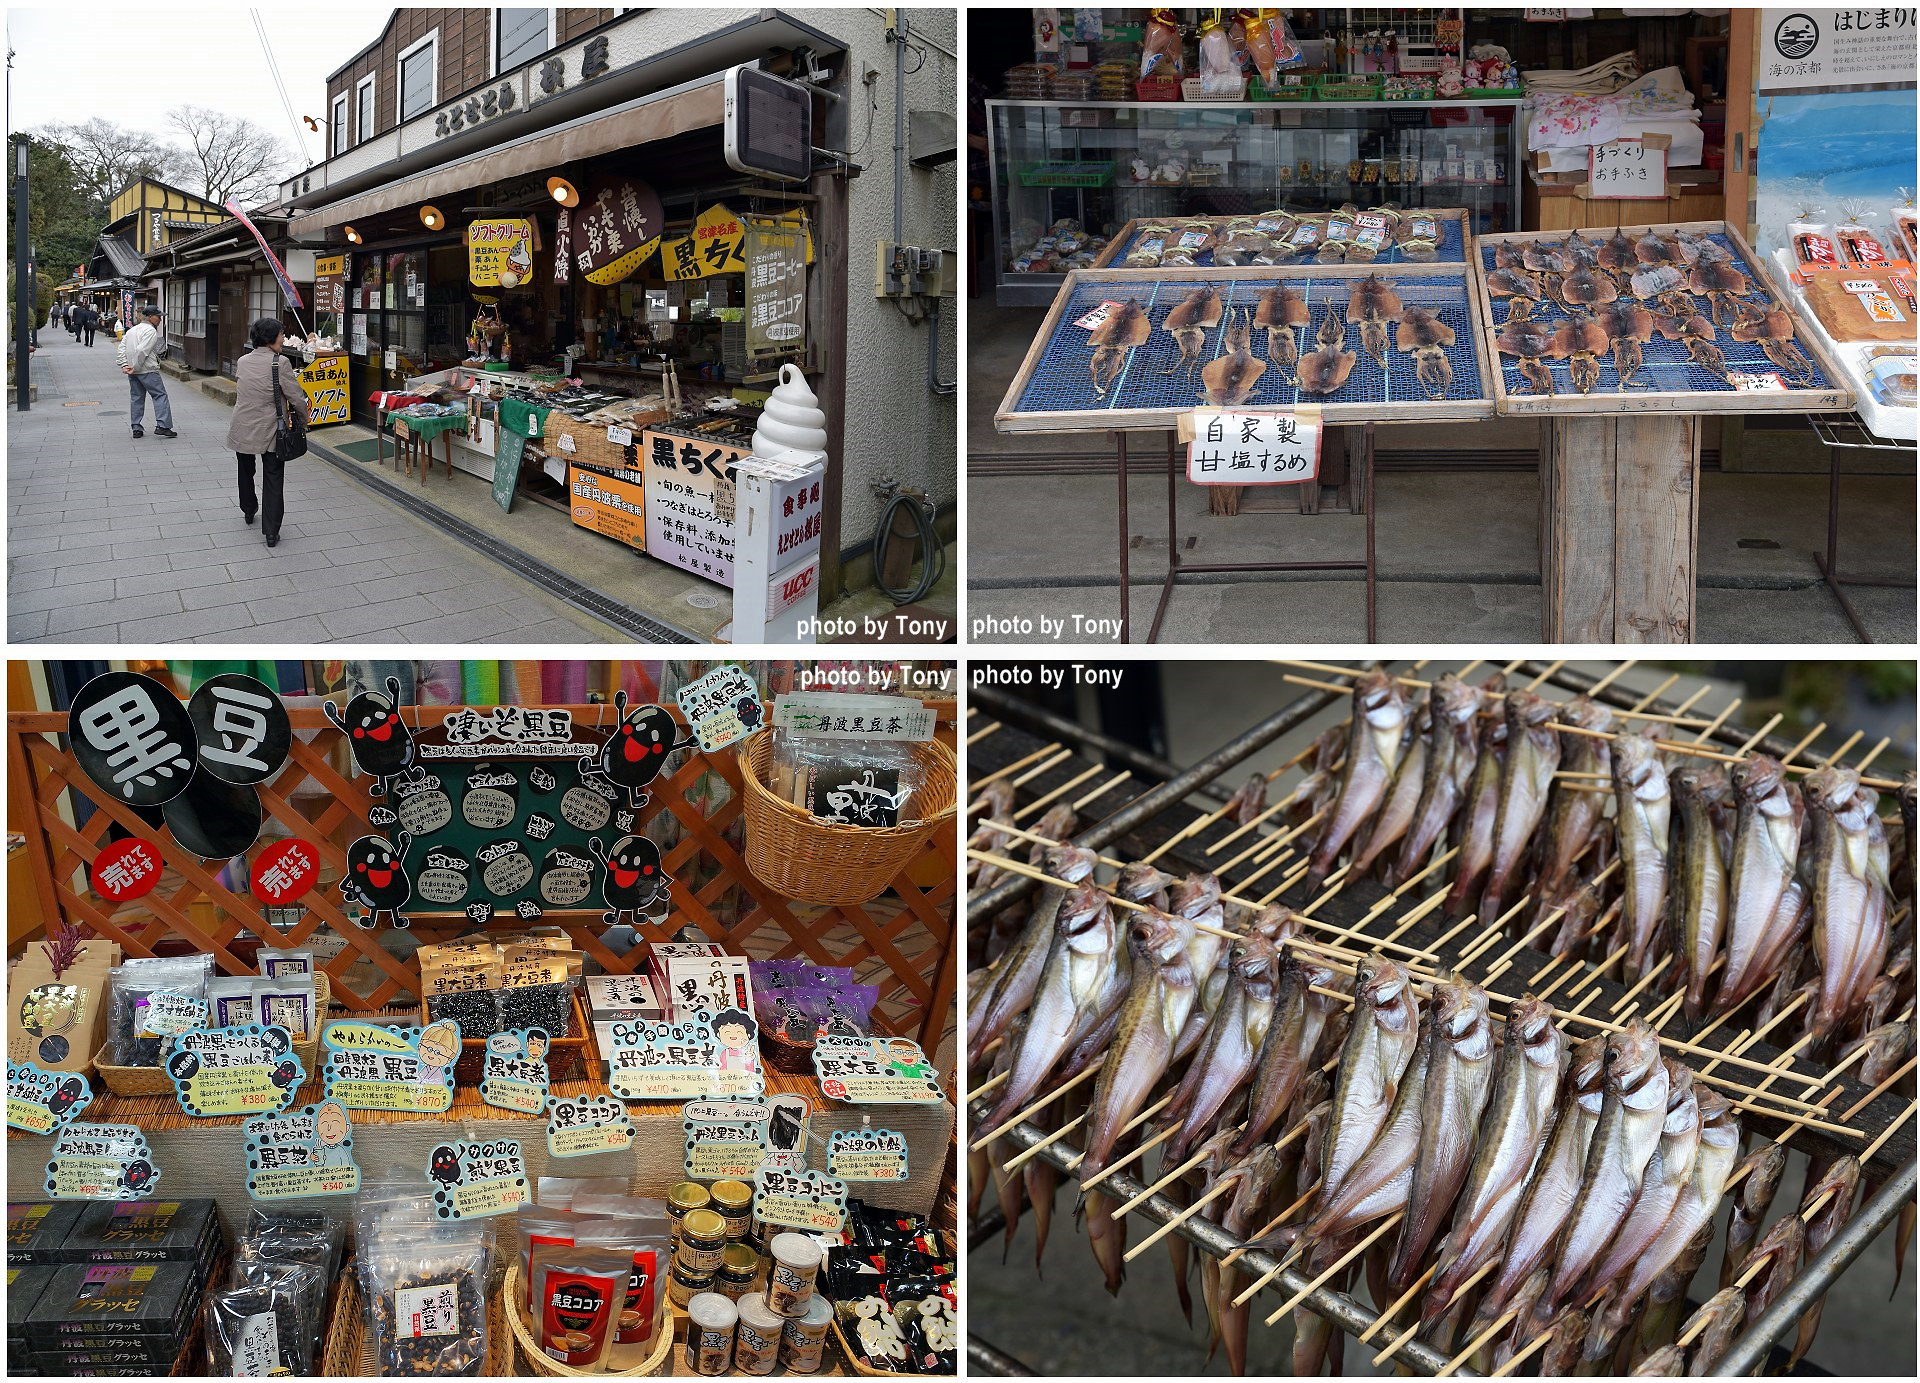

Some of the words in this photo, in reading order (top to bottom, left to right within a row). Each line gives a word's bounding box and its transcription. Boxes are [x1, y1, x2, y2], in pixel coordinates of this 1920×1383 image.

[1769, 61, 1822, 76] 海の京都
[1596, 146, 1645, 162] 手づくり
[1595, 167, 1647, 180] お手ふき
[757, 293, 803, 327] 黒豆ココア
[302, 368, 348, 383] 黒豆あん
[314, 389, 346, 403] ソフト
[310, 405, 347, 422] クリーム
[1207, 416, 1302, 445] 自家製
[1194, 449, 1307, 472] 甘塩するめ
[783, 566, 814, 601] UCC
[787, 589, 807, 606] COFFEE
[816, 715, 904, 734] 丹波黒豆茶
[433, 973, 489, 994] 黒大豆煮
[500, 969, 552, 989] 黒大豆煮
[617, 1043, 720, 1068] 丹波の黒豆煮
[383, 1057, 418, 1081] 黒豆
[488, 1056, 547, 1084] 黒大豆煮
[820, 1060, 880, 1077] 黒大豆
[646, 1084, 669, 1095] ¥470
[241, 1094, 266, 1105] ¥380
[416, 1096, 441, 1107] ¥870
[515, 1096, 536, 1109] ¥540
[25, 1115, 47, 1128] ¥650
[555, 1103, 621, 1129] 黒豆ココア
[607, 1133, 627, 1144] ¥540
[470, 1142, 518, 1158] サクサク
[721, 1167, 747, 1175] ¥540
[872, 1169, 895, 1178] ¥380
[322, 1182, 343, 1190] ¥540
[502, 1192, 521, 1203] ¥540
[812, 1215, 838, 1227] ¥540
[7, 1232, 33, 1244] ッセ
[101, 1230, 166, 1243] グラッセ
[91, 1250, 167, 1260] 丹波黒豆グラッセ
[69, 1298, 140, 1314] グラッセ
[551, 1293, 604, 1312] 黒豆ココア
[421, 1298, 438, 1331] 黒豆
[60, 1322, 141, 1333] 丹波黒豆グラッセ
[61, 1339, 142, 1348] 丹波黒豆グラッセ
[66, 1353, 148, 1364] 丹波黒豆グラッセ
